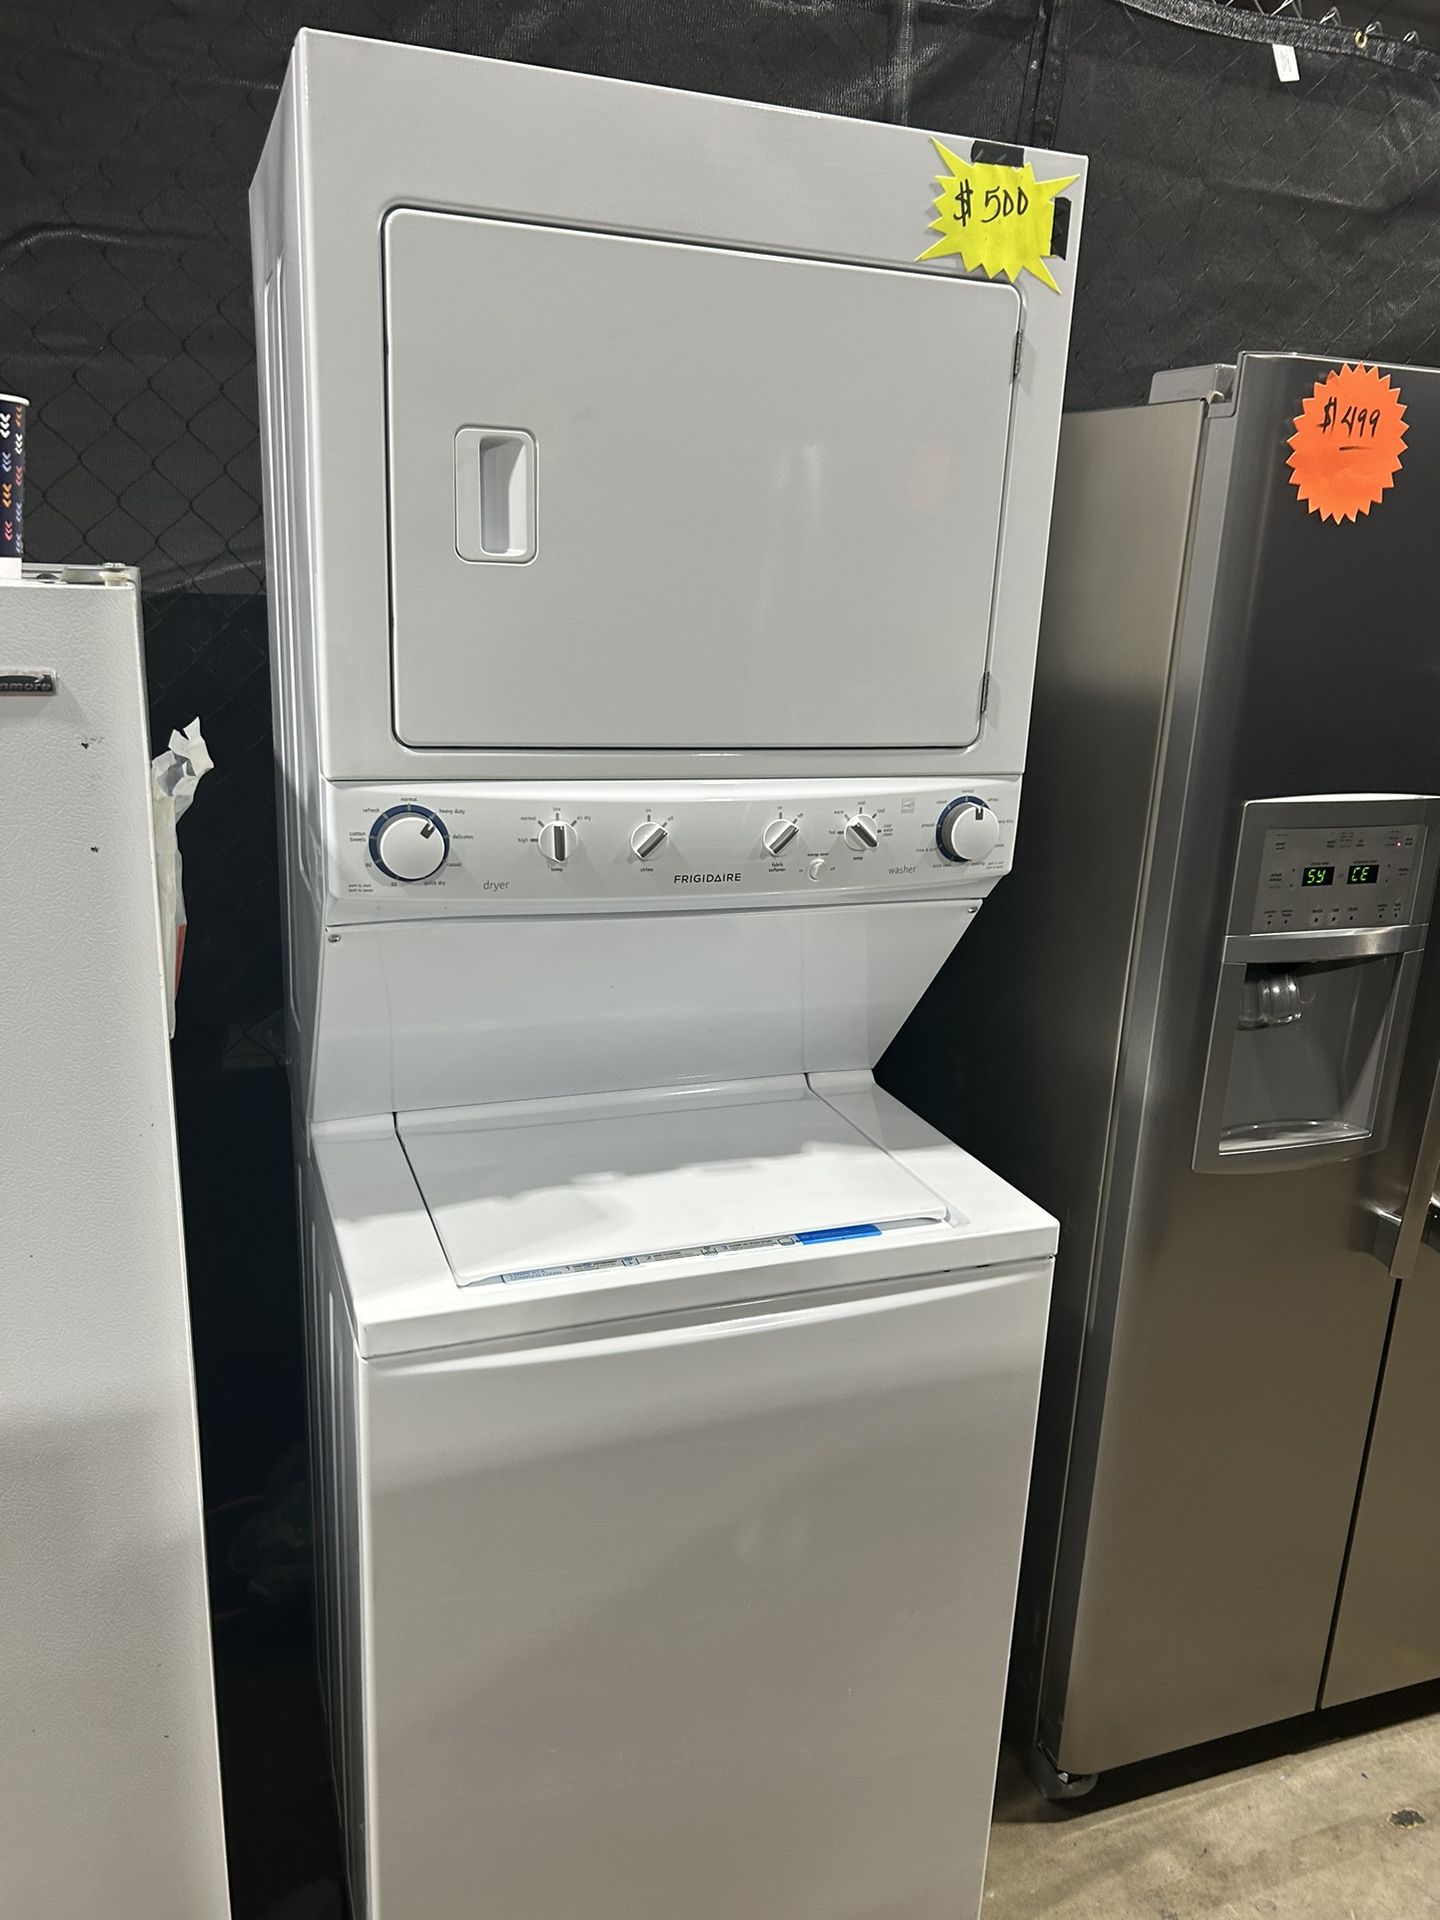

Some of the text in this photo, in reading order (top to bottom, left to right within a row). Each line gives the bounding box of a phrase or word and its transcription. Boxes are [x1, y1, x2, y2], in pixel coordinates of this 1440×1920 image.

[888, 865, 917, 875] washer
[673, 872, 742, 884] FRIGIDAIRE
[483, 880, 510, 892] dryer
